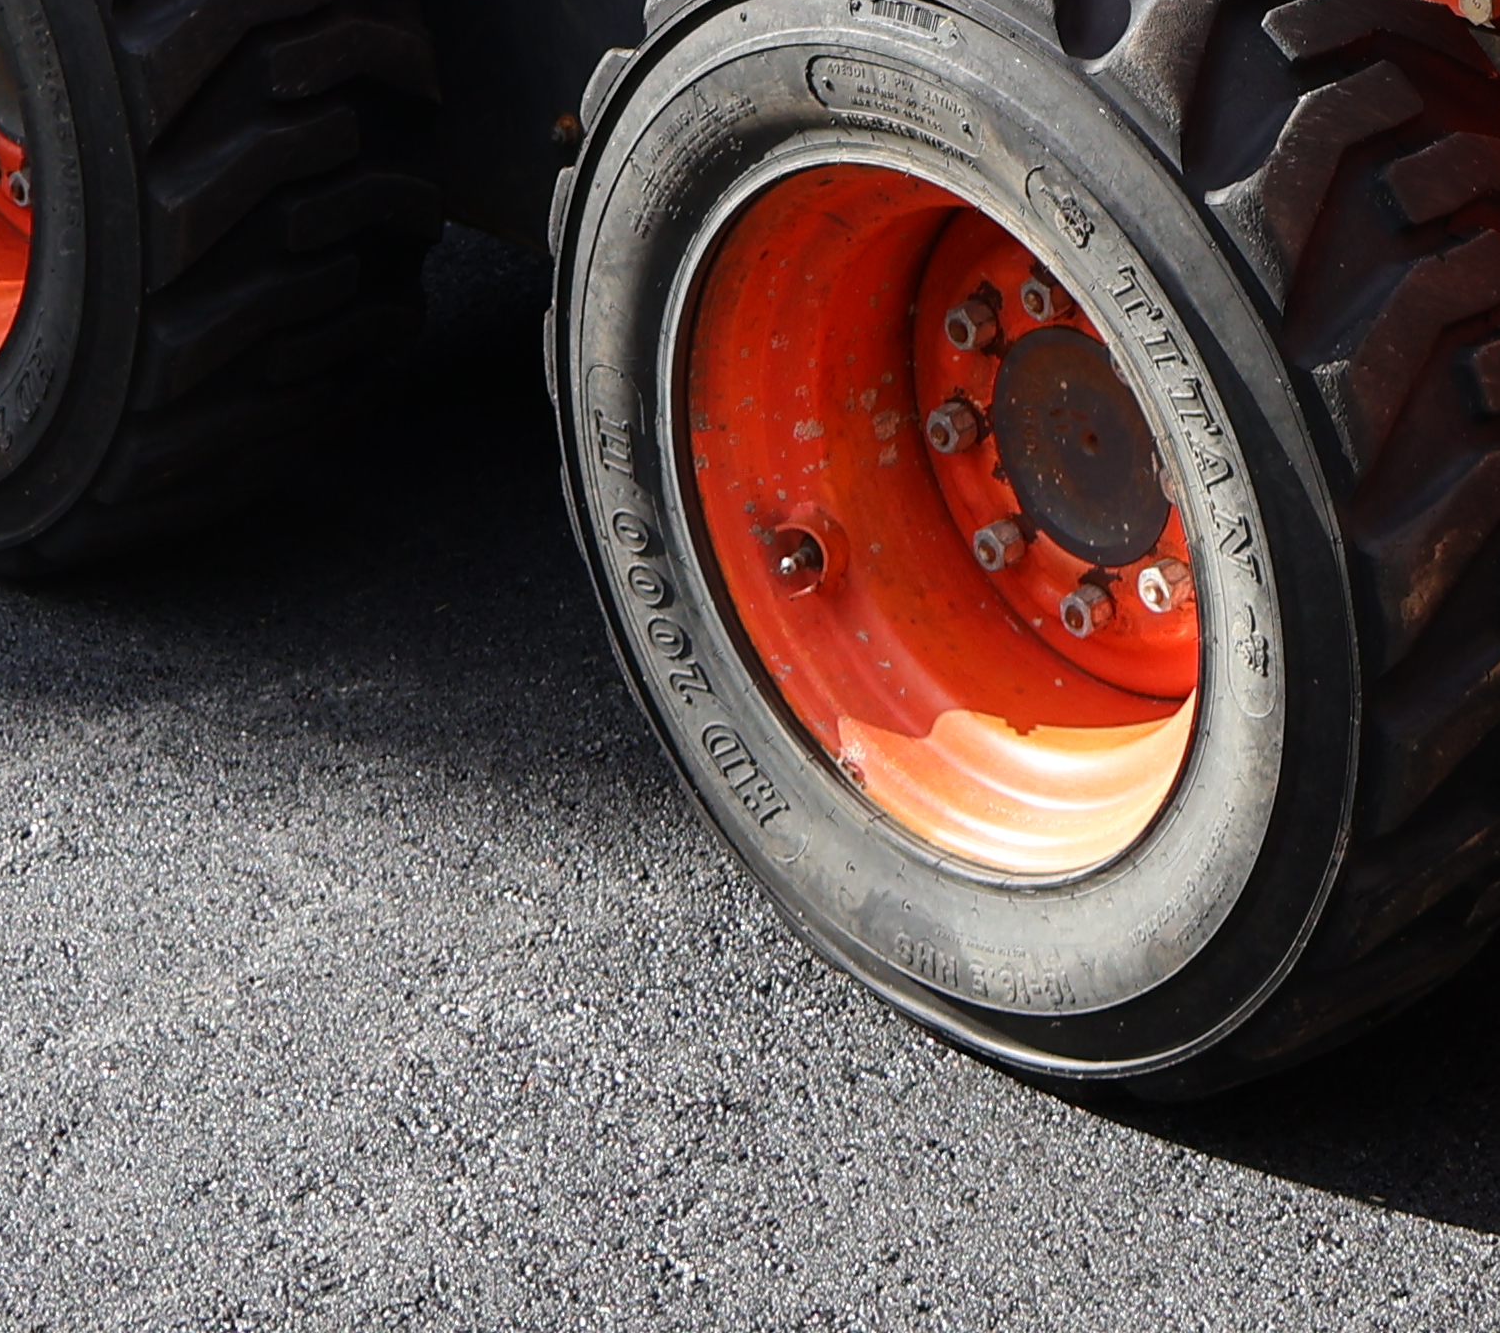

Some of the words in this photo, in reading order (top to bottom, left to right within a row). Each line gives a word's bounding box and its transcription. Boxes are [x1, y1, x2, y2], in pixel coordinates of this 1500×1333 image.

[923, 88, 968, 119] RATING
[1107, 265, 1262, 585] TITAN
[612, 508, 716, 705] 2000
[702, 719, 792, 829] HD
